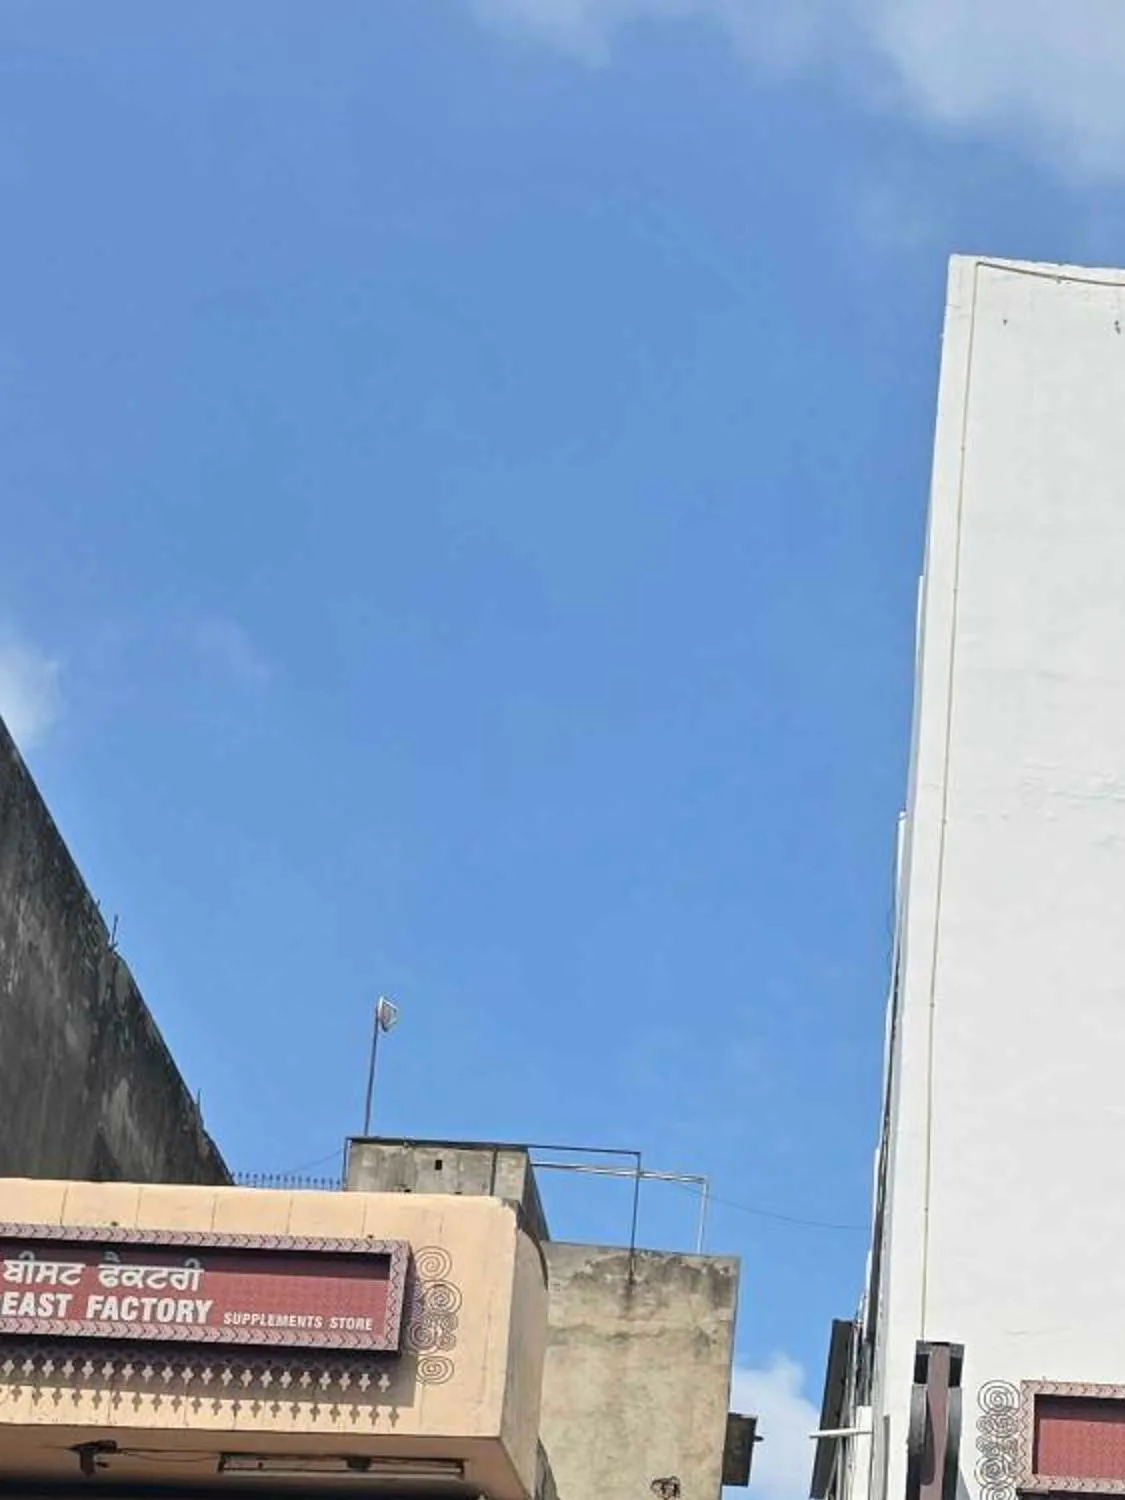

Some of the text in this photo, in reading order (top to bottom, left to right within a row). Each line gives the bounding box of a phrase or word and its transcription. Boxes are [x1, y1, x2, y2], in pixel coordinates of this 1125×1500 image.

[3, 1251, 204, 1291] ਬੀਸਟ ਫੈਕਟਰੀ
[86, 1295, 213, 1324] FACTORY
[223, 1311, 323, 1329] SUPPLEMENTS
[330, 1317, 373, 1331] STORE
